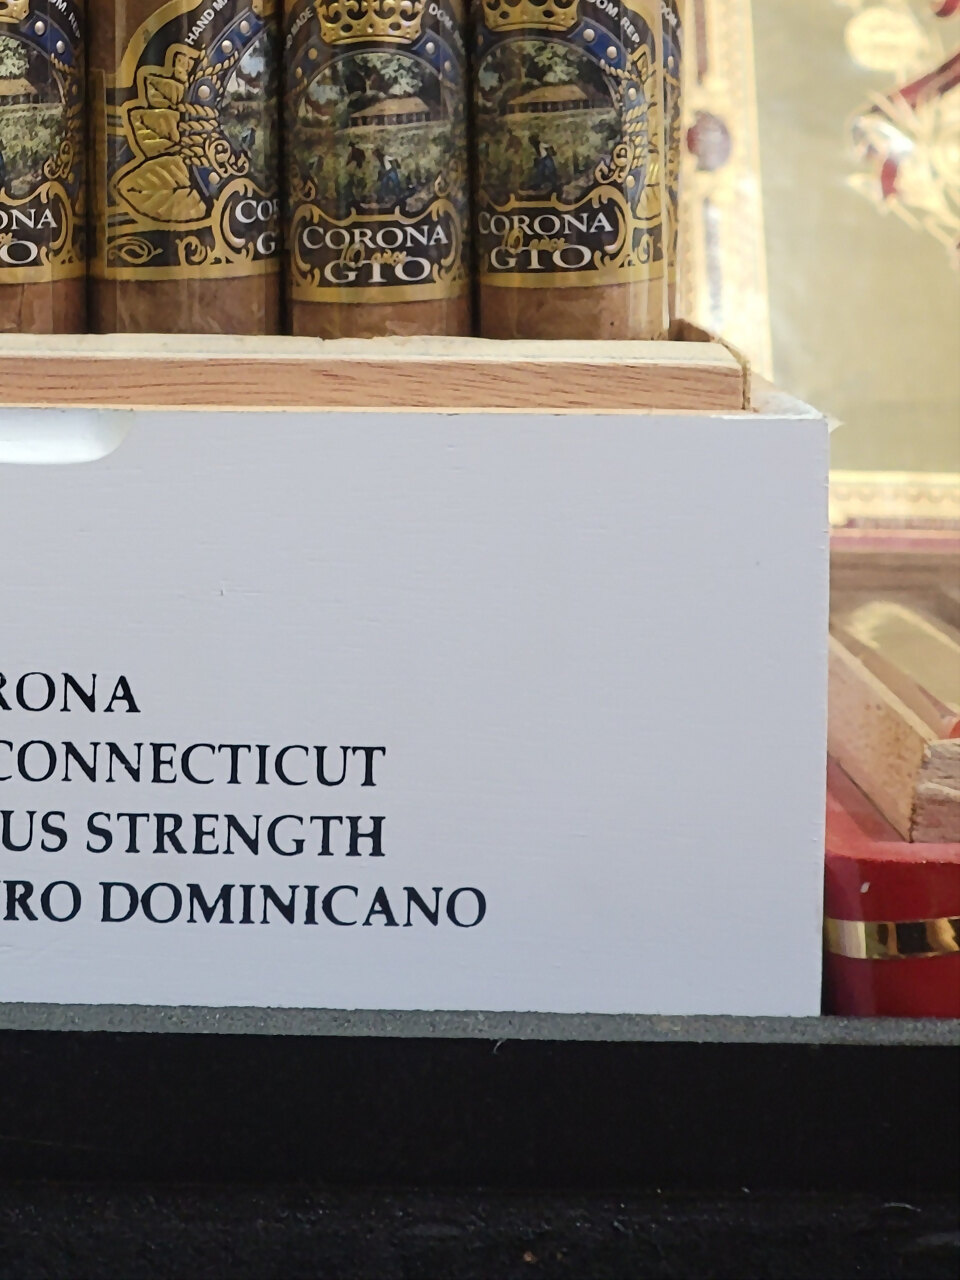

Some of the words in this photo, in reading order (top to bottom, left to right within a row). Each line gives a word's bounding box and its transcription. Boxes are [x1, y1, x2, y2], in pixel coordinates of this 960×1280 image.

[184, 8, 216, 46] HAND
[302, 224, 449, 250] CORONA
[477, 211, 614, 236] CORONA
[324, 256, 432, 284] GTO
[490, 243, 592, 270] GTO
[86, 811, 386, 857] STRENGTH
[98, 881, 487, 928] DOMINICANO
